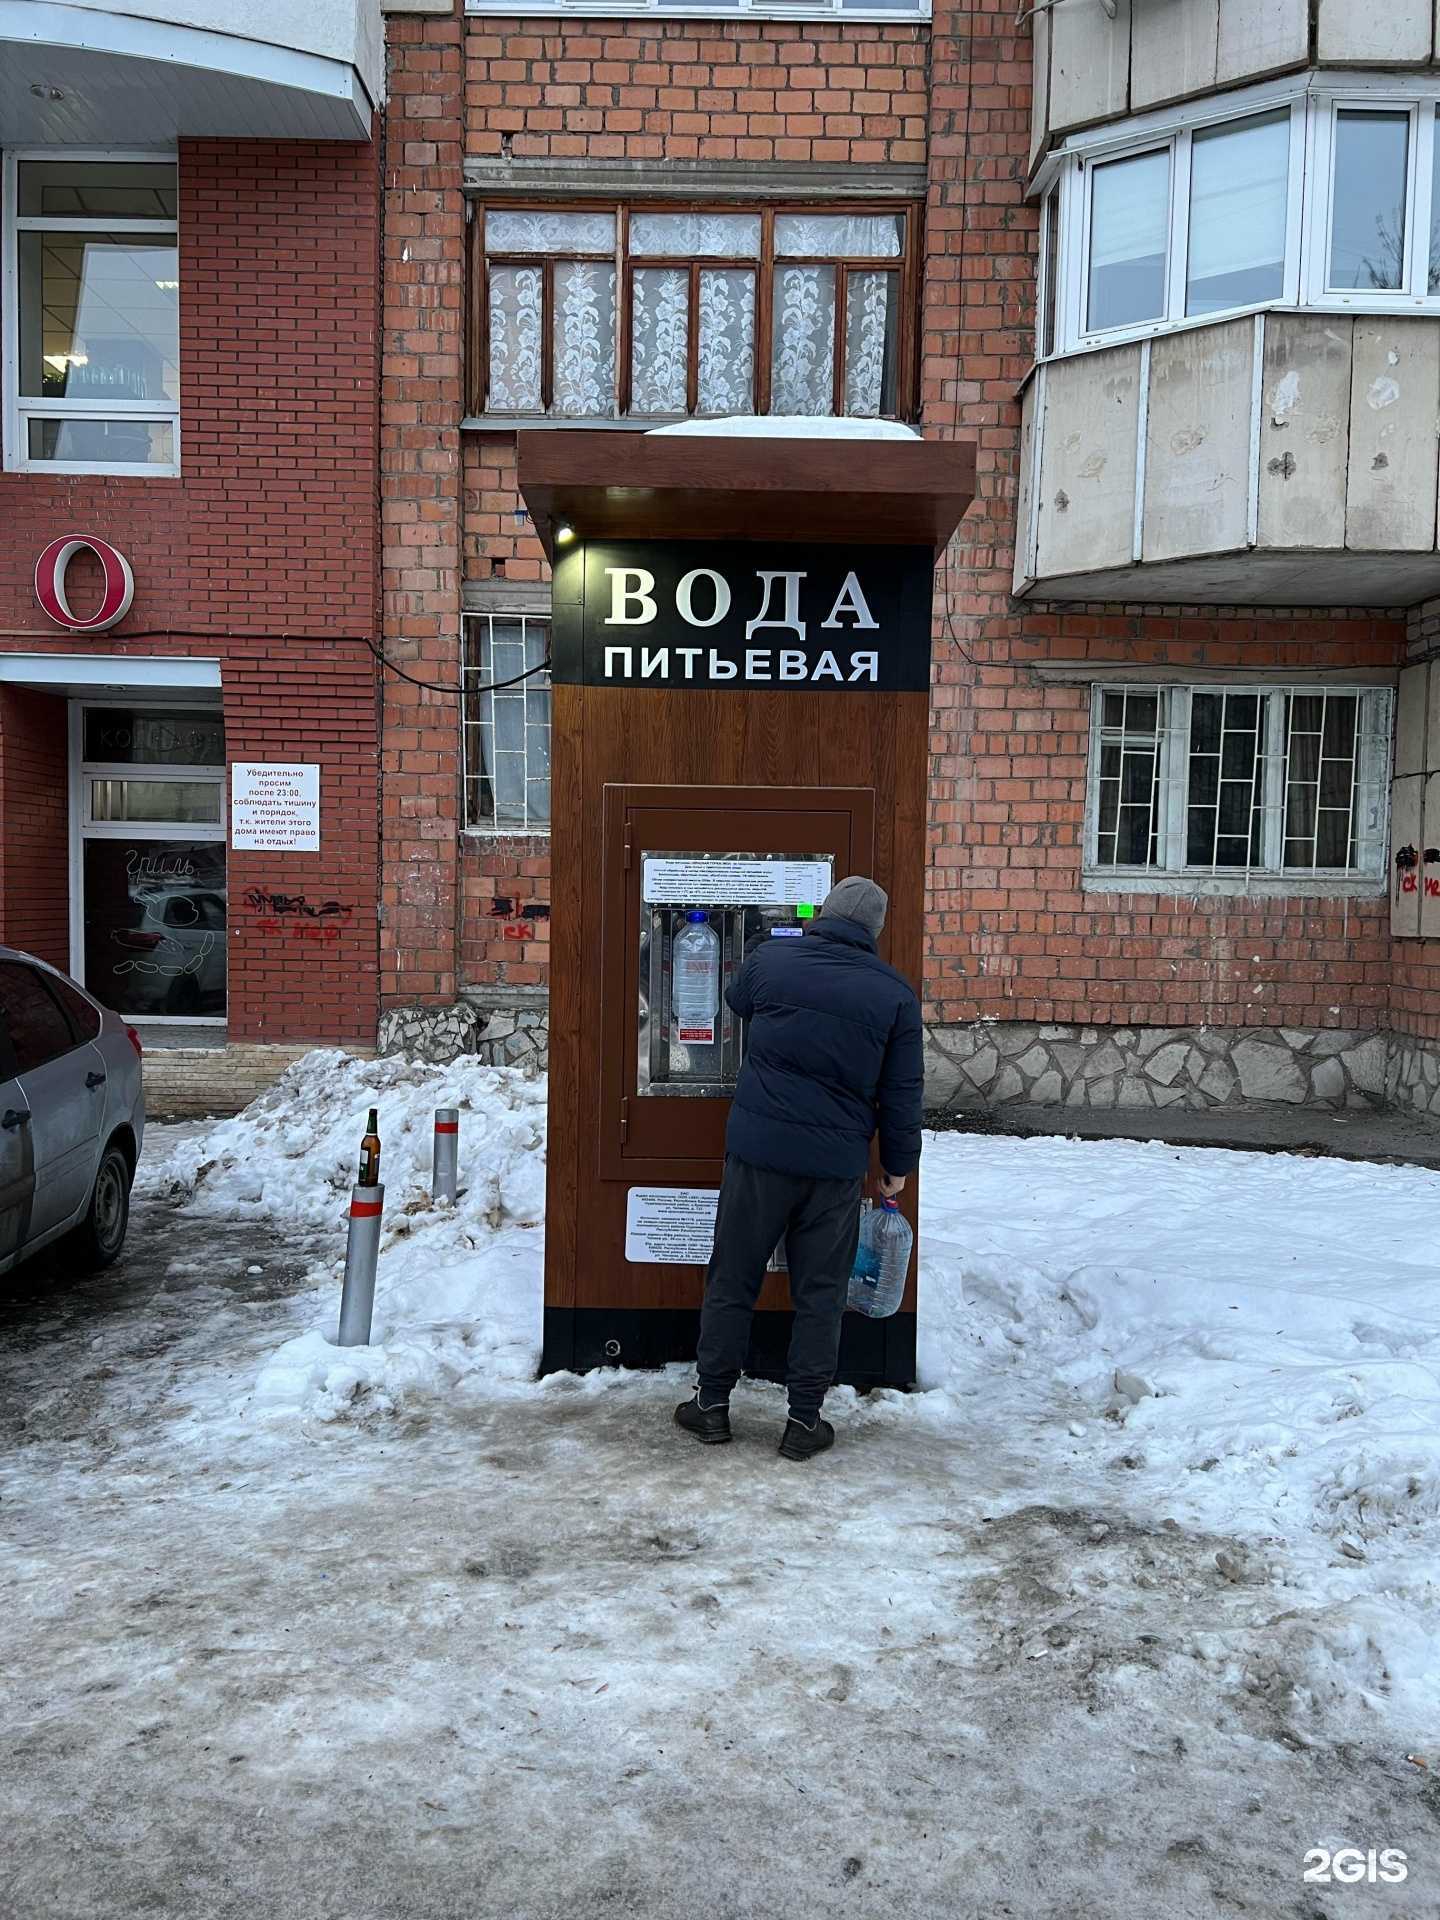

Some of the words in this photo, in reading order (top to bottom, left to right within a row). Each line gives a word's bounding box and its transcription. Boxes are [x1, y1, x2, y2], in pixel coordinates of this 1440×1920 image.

[604, 568, 880, 640] ВОДА
[604, 646, 879, 682] ПИТЬЕВАЯ
[246, 769, 304, 777] Убедительно
[285, 800, 317, 808] тишину
